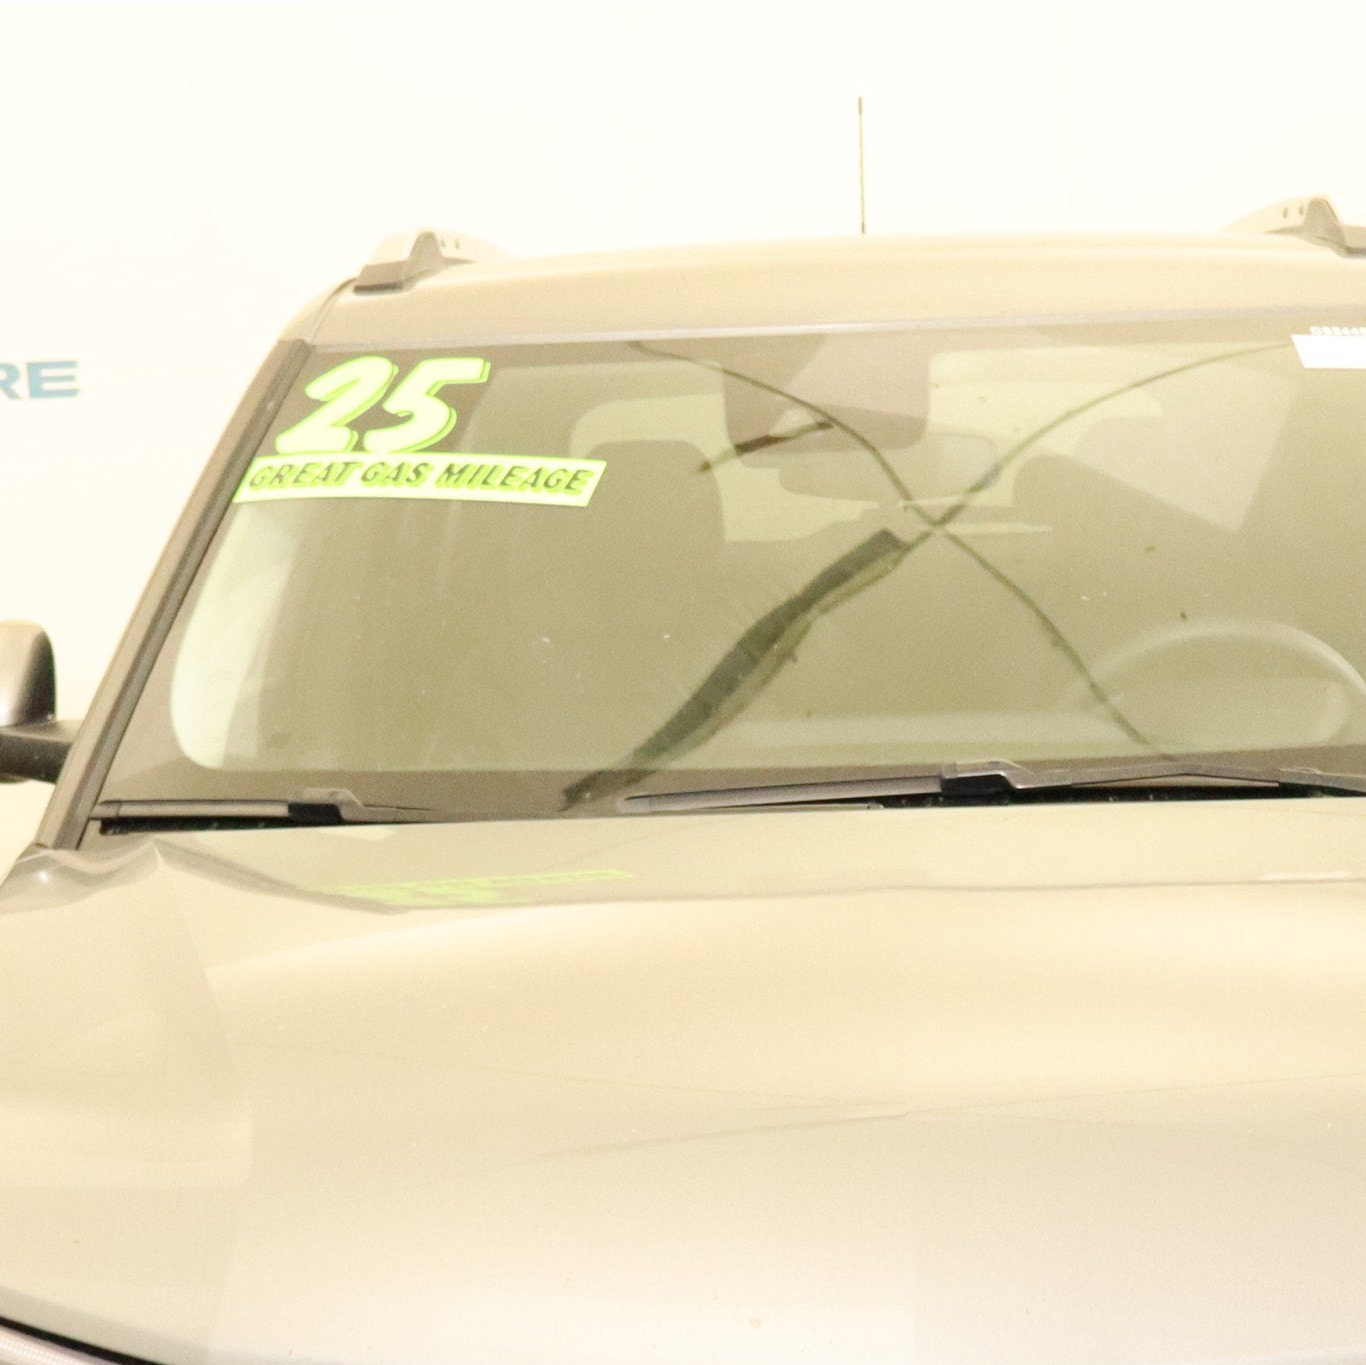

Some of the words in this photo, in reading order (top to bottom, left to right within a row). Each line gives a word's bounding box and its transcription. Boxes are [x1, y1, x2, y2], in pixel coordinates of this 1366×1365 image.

[275, 356, 490, 454] 25
[249, 461, 361, 490] GREAT
[360, 461, 433, 487] GAS
[435, 463, 595, 495] MILEAGE
